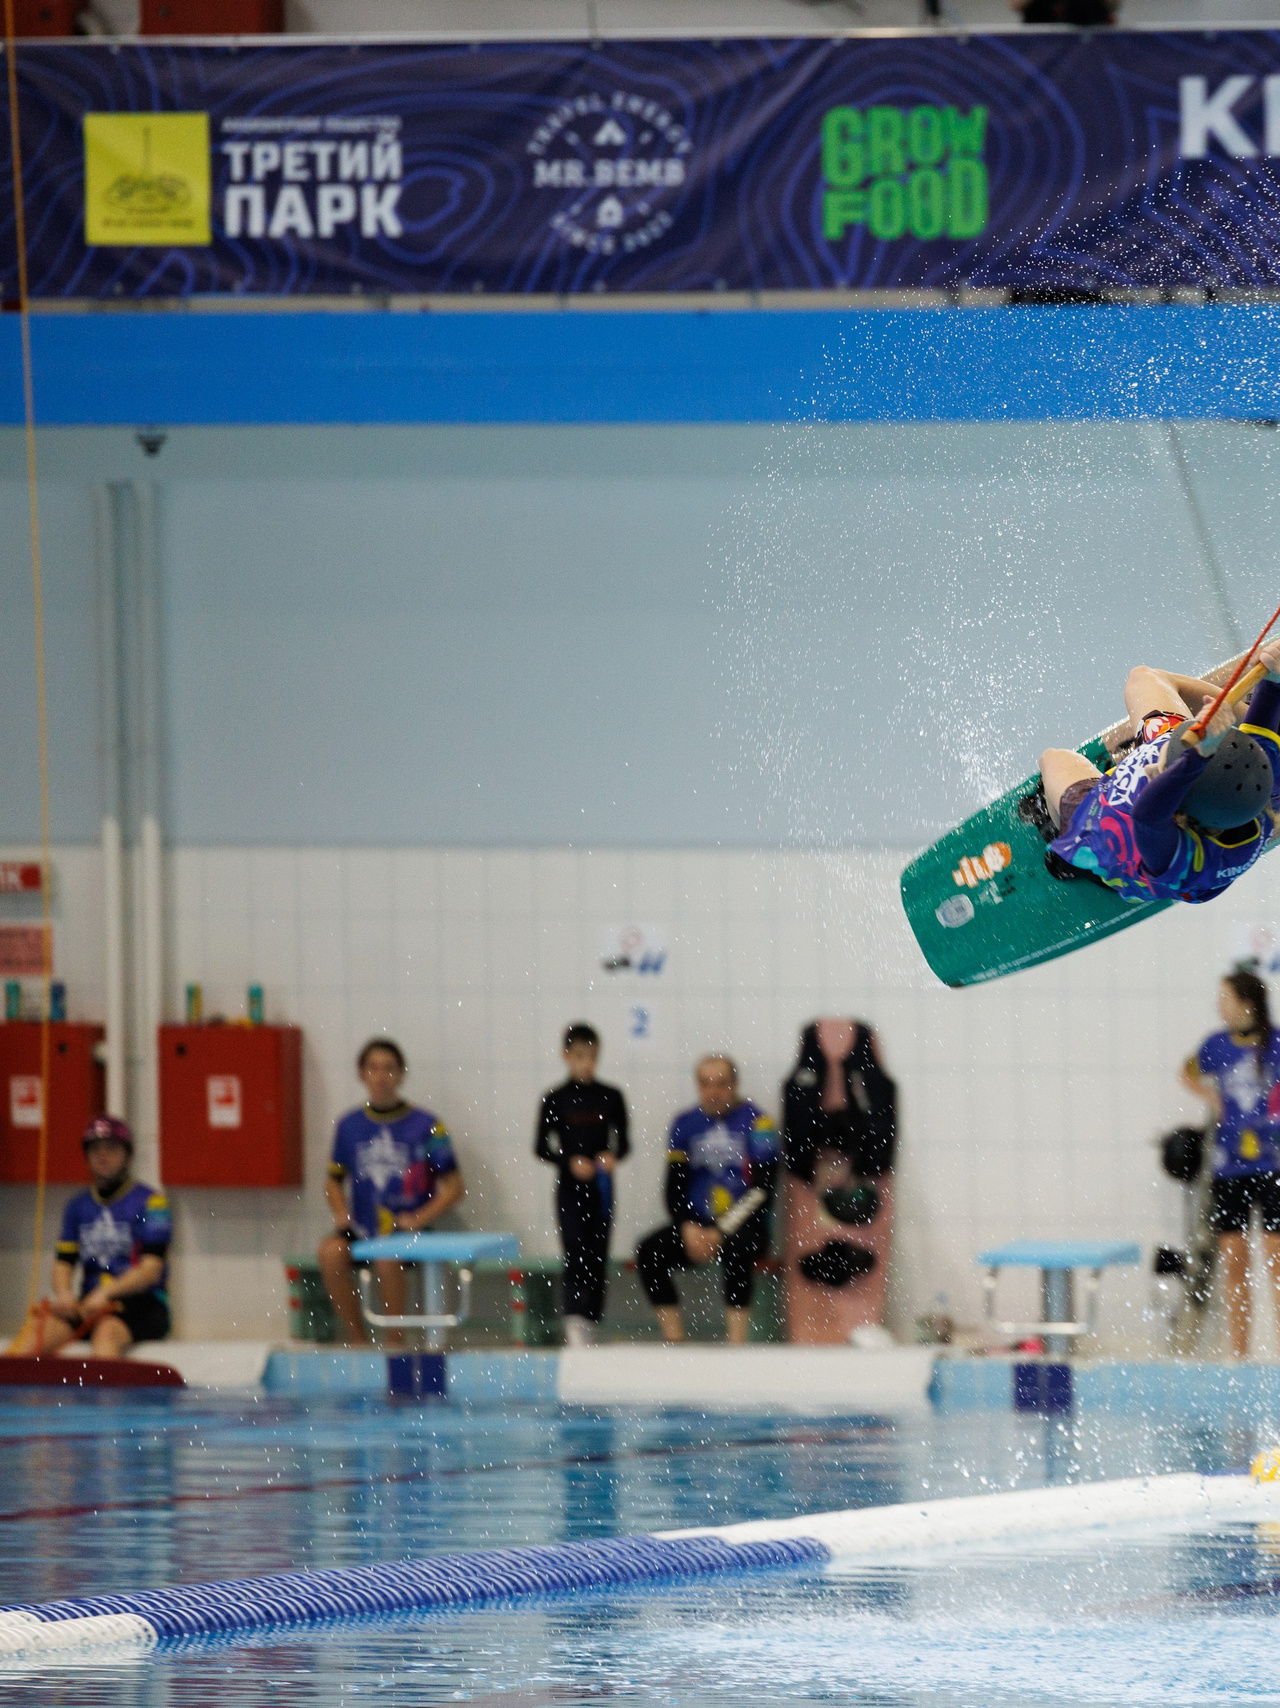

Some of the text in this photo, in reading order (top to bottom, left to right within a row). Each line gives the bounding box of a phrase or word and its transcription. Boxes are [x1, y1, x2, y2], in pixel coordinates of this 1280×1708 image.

[222, 133, 401, 182] ТРЕТИЙ
[820, 104, 989, 187] GROW
[223, 183, 402, 240] ПАРК
[821, 156, 989, 242] FOOD
